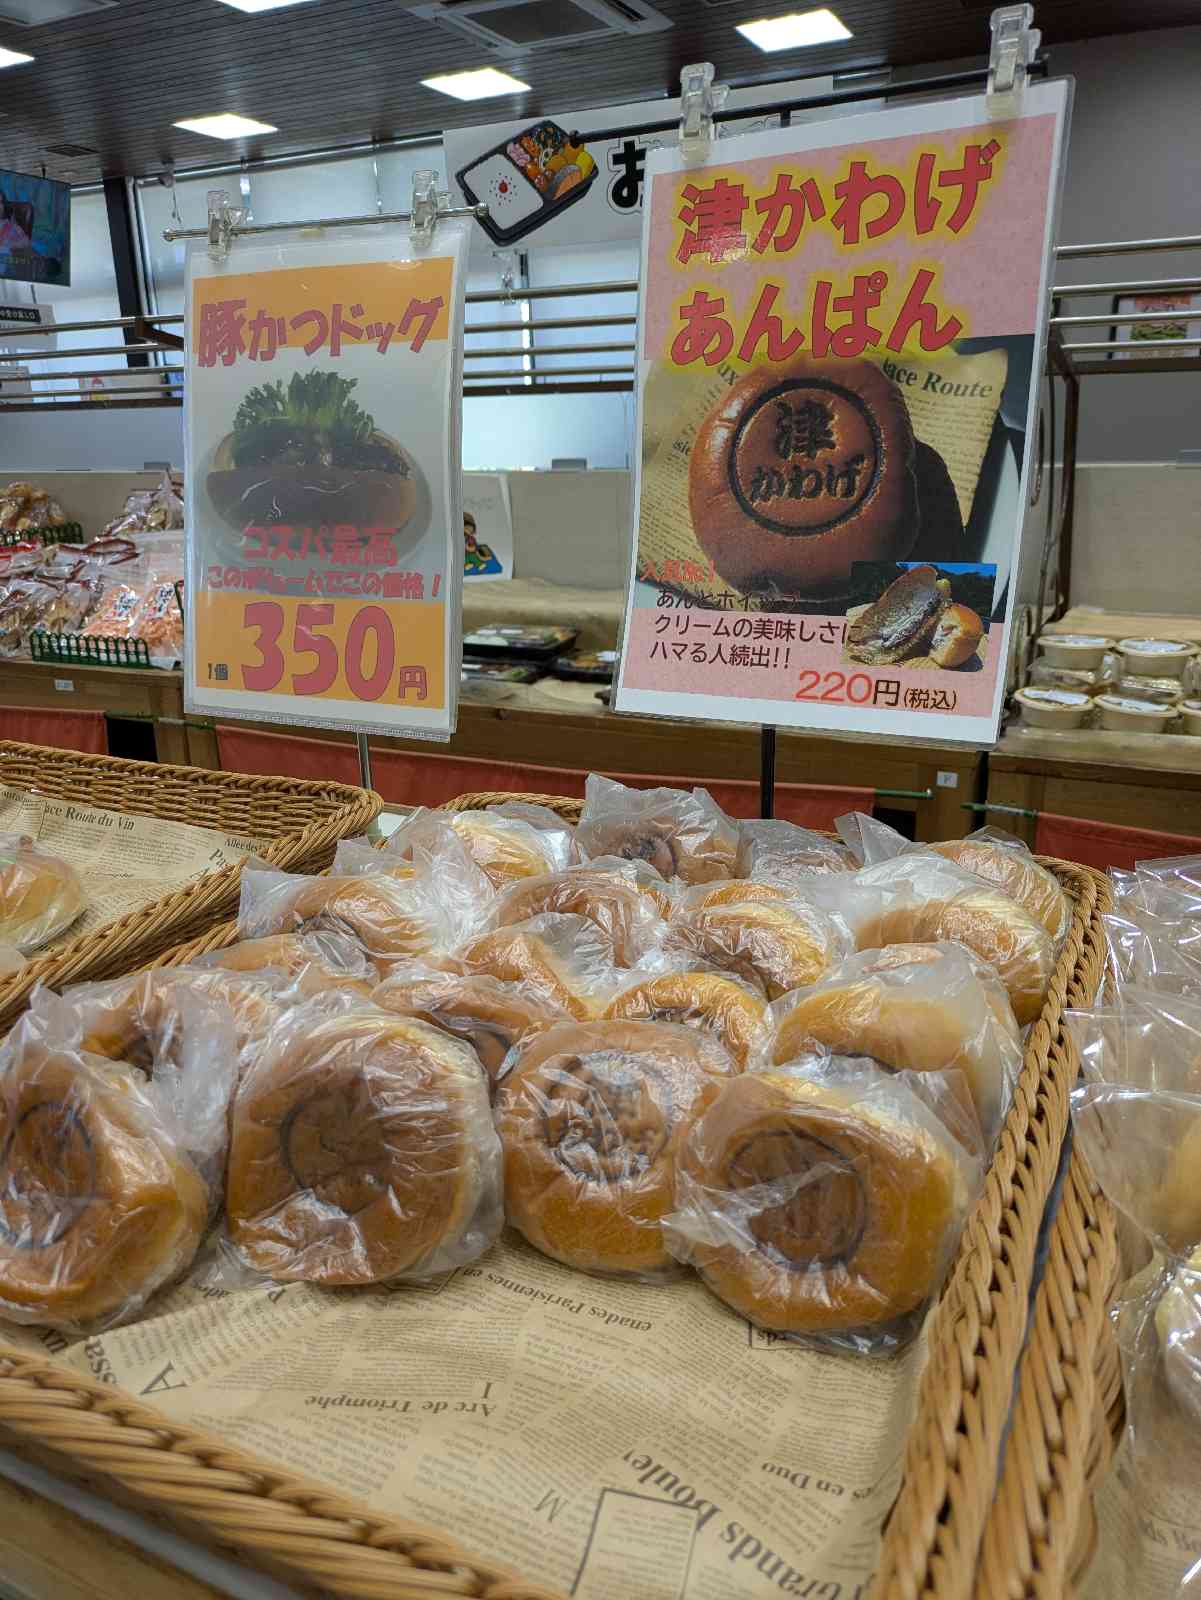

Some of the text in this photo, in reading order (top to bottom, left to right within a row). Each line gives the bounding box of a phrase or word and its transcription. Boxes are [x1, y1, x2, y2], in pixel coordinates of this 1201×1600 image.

[675, 138, 1002, 265] 津かわげ
[197, 295, 445, 368] 豚かつドッグ
[670, 269, 963, 366] あんぱん
[920, 370, 993, 399] Route
[775, 399, 837, 461] 津
[750, 453, 867, 502] かわげ
[241, 522, 399, 567] コスパ最高
[654, 614, 864, 645] クリームの美味しさに
[96, 813, 114, 827] du
[117, 816, 135, 831] Vin
[484, 1272, 586, 1315] Parisiennes
[587, 1305, 653, 1334] enades
[303, 1394, 497, 1418] Arc de Triomphe
[759, 1460, 812, 1491] Duo
[816, 1479, 845, 1499] en
